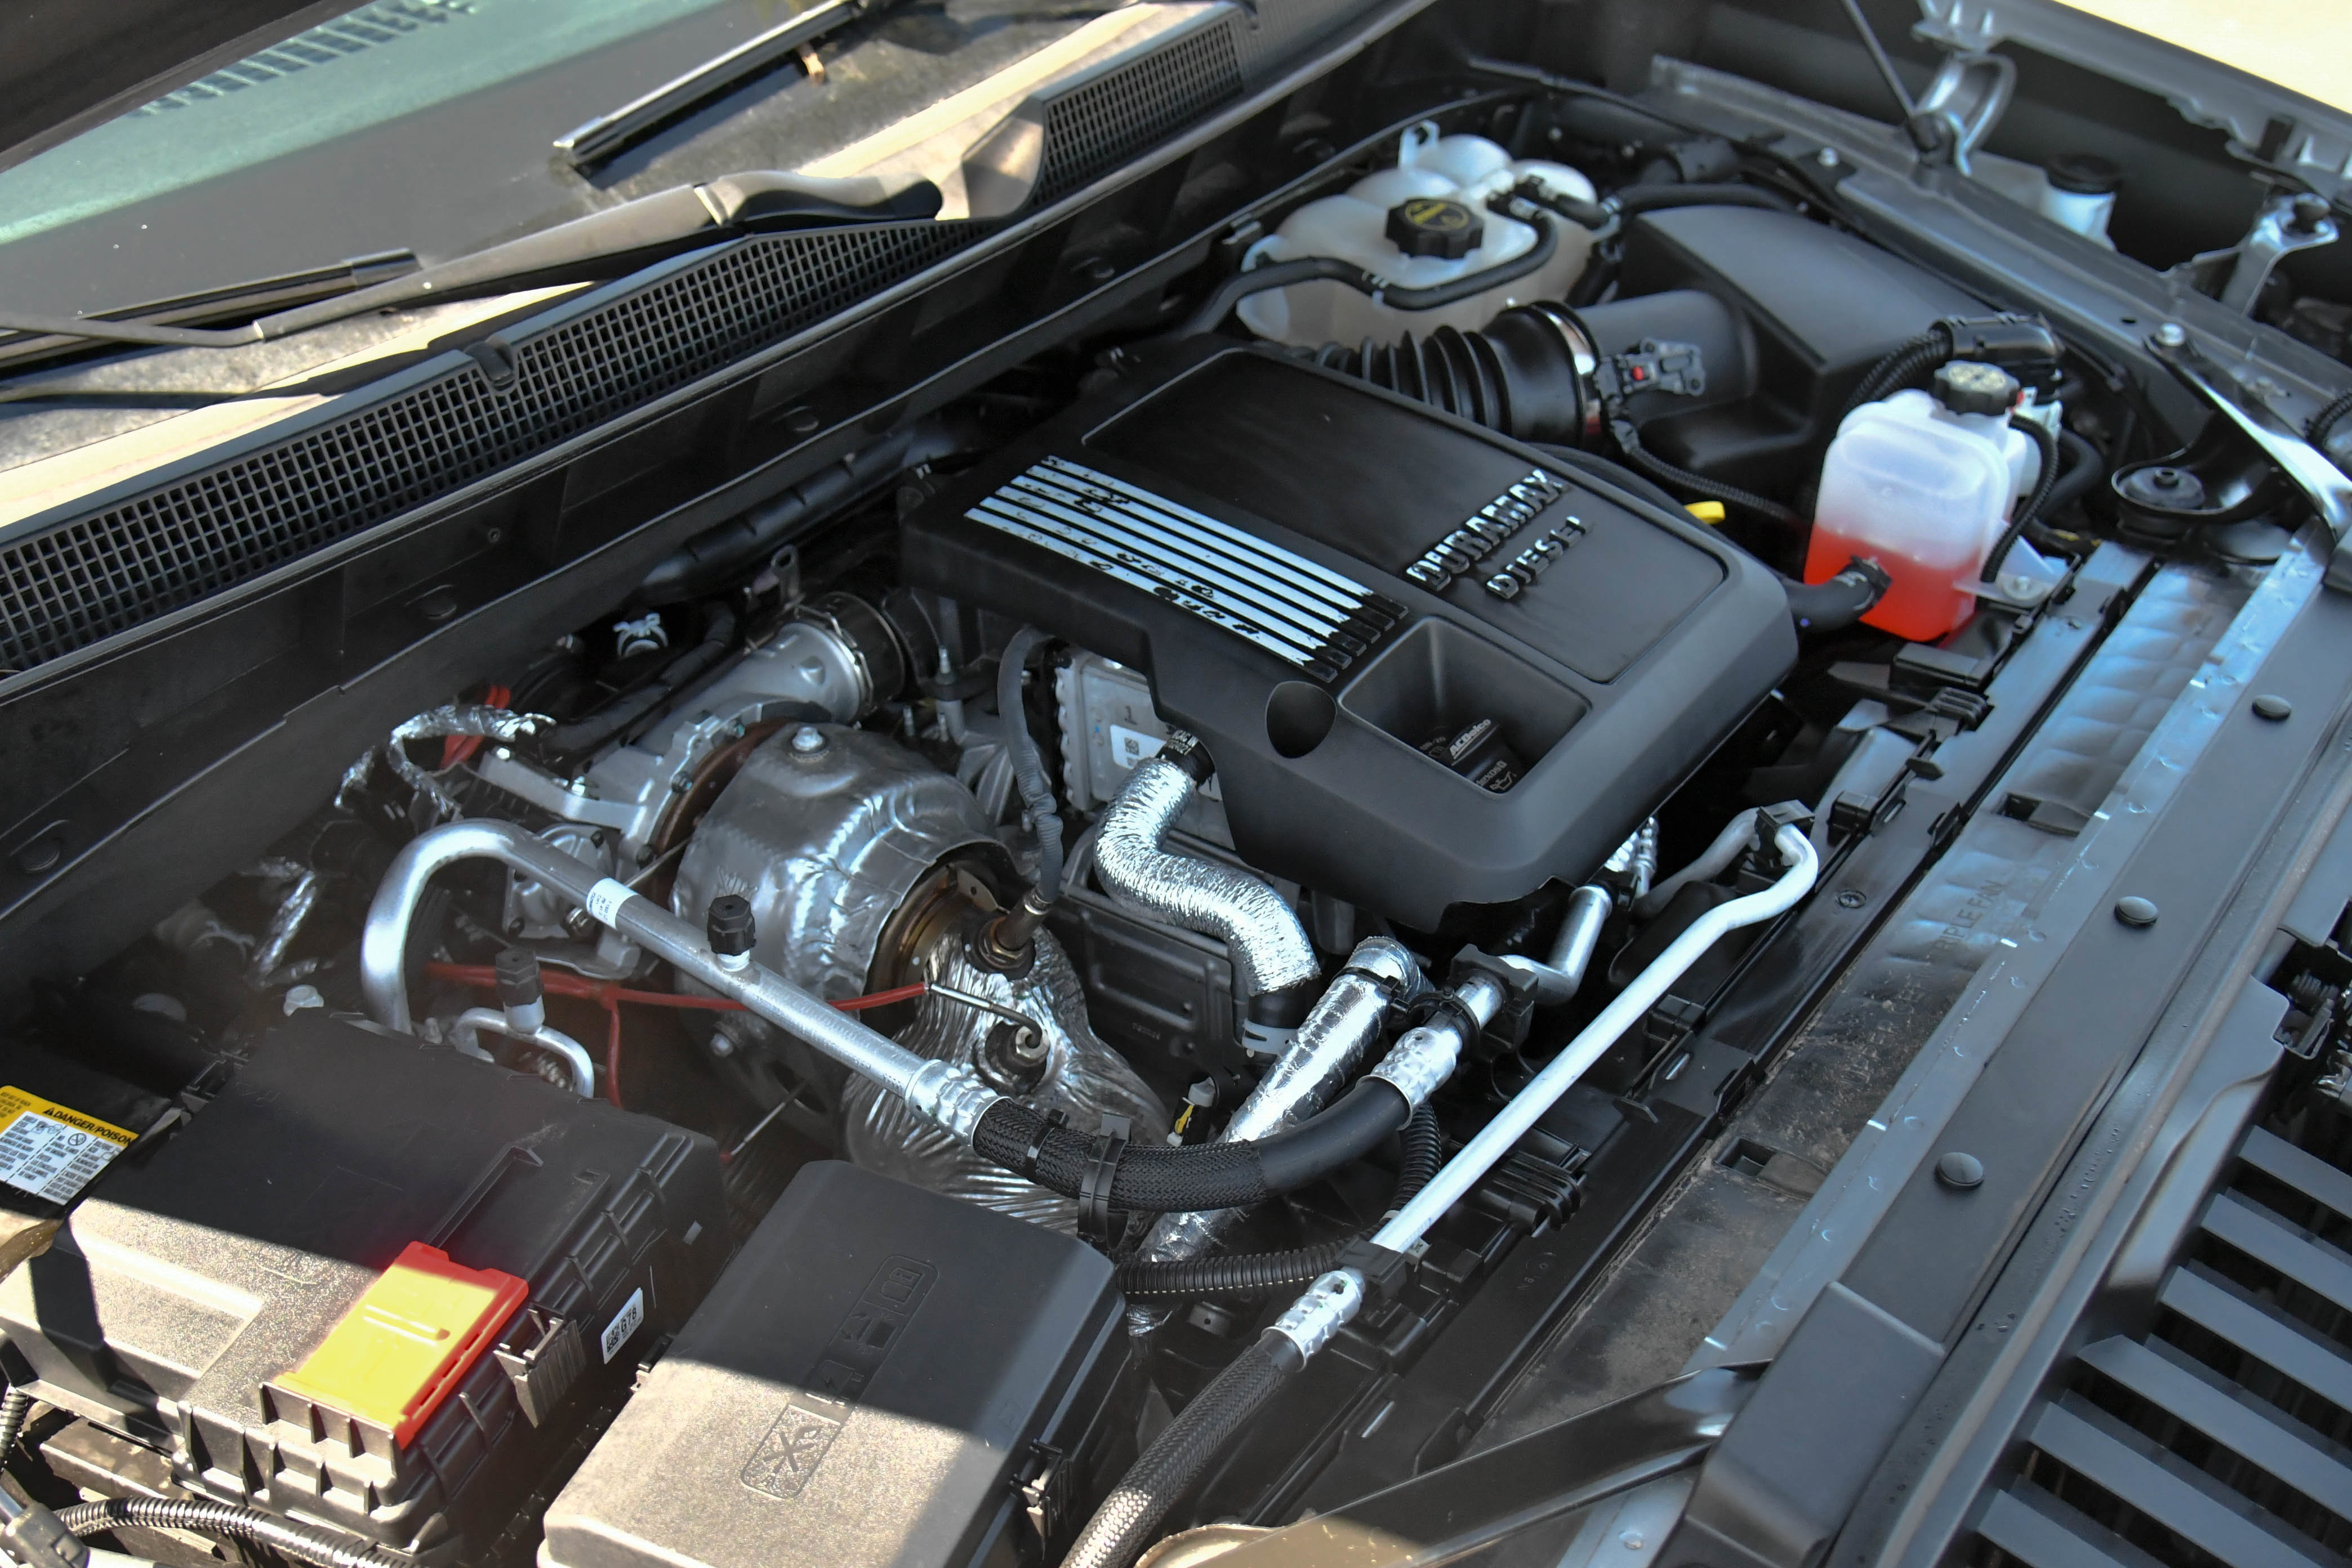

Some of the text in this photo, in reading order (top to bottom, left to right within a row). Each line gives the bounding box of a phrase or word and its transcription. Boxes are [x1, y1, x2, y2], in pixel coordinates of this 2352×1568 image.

[1406, 469, 1563, 591] DURAMAX
[1486, 515, 1588, 600] DIESEL
[1449, 719, 1491, 757] ACDelco
[54, 1111, 135, 1144] DANGER/POISON
[621, 1307, 637, 1333] G78
